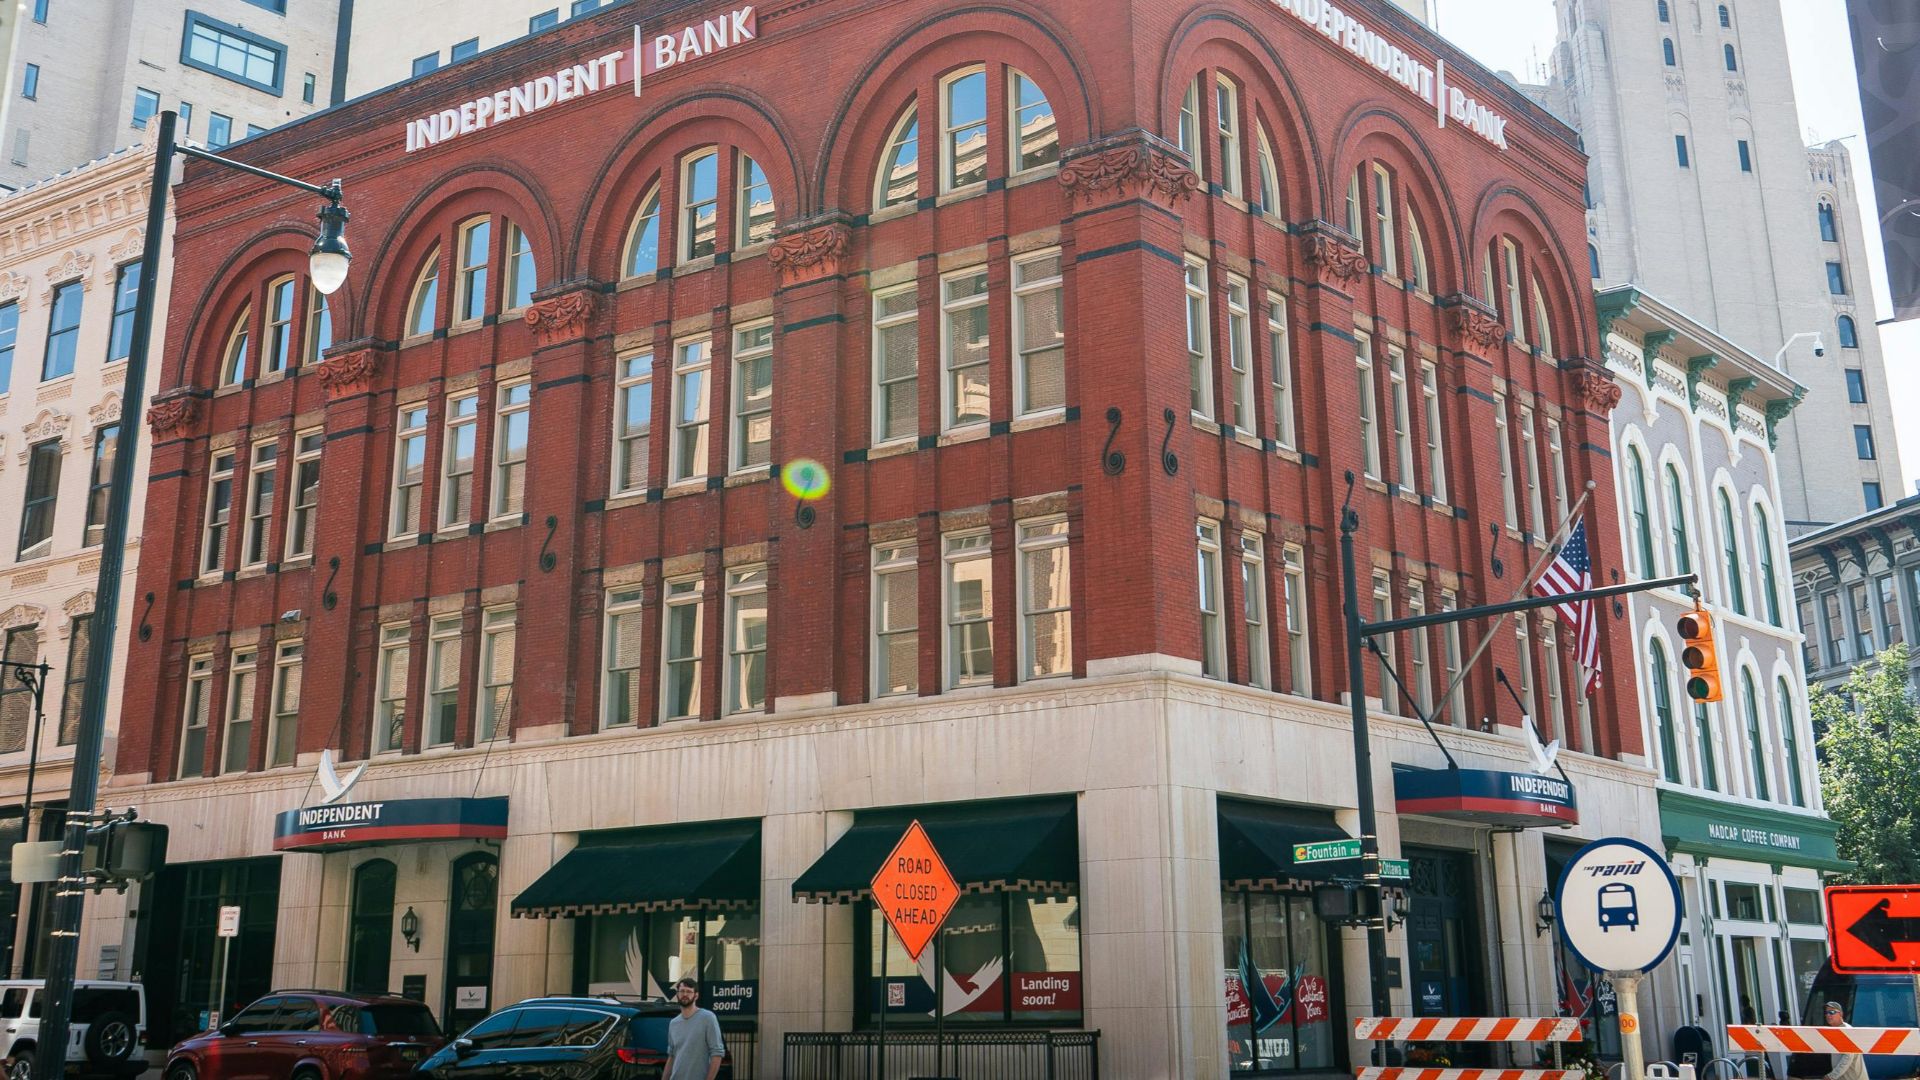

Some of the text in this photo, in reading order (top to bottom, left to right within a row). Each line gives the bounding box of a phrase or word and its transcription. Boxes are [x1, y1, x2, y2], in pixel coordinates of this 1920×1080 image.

[405, 5, 757, 153] INDEPENDENT BANK
[1271, 0, 1508, 150] NDEPENDENT BANK
[1511, 775, 1569, 799] INDEPENDENT
[299, 803, 383, 826] INDEPENDENT
[1540, 803, 1557, 814] BANK
[323, 829, 346, 840] BANK
[1708, 823, 1800, 850] MADCAP COFFEE COMPANY
[1306, 843, 1347, 860] Fountain
[898, 857, 932, 875] ROAD
[1382, 862, 1401, 876] Ottawa
[895, 883, 938, 901] CLOSED
[895, 907, 937, 925] AHEAD
[712, 984, 753, 998] Landing
[1021, 976, 1070, 992] Landing
[712, 1000, 741, 1011] soon!
[1022, 992, 1056, 1006] soon!
